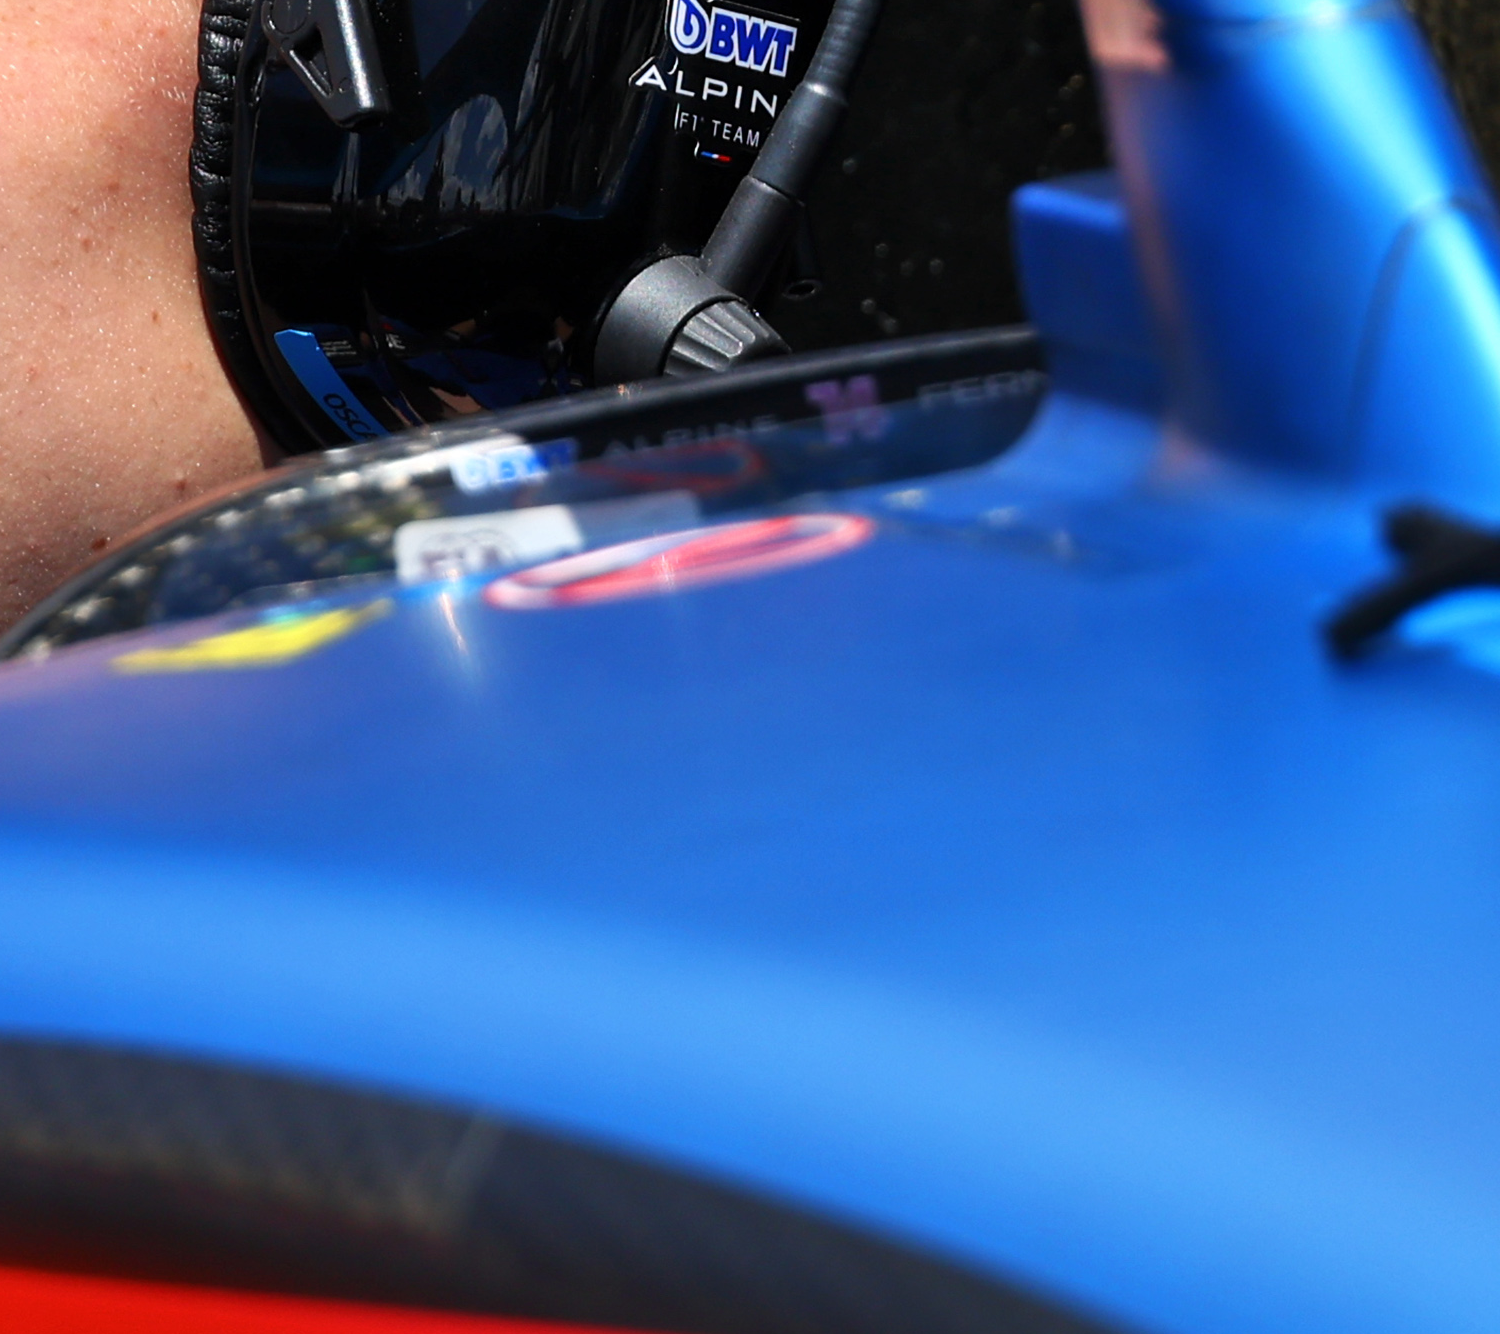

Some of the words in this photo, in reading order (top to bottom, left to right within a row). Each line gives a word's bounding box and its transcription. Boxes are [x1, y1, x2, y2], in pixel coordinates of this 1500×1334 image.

[705, 7, 797, 77] BWT
[635, 64, 779, 117] ALPIN
[711, 120, 760, 147] TEAM
